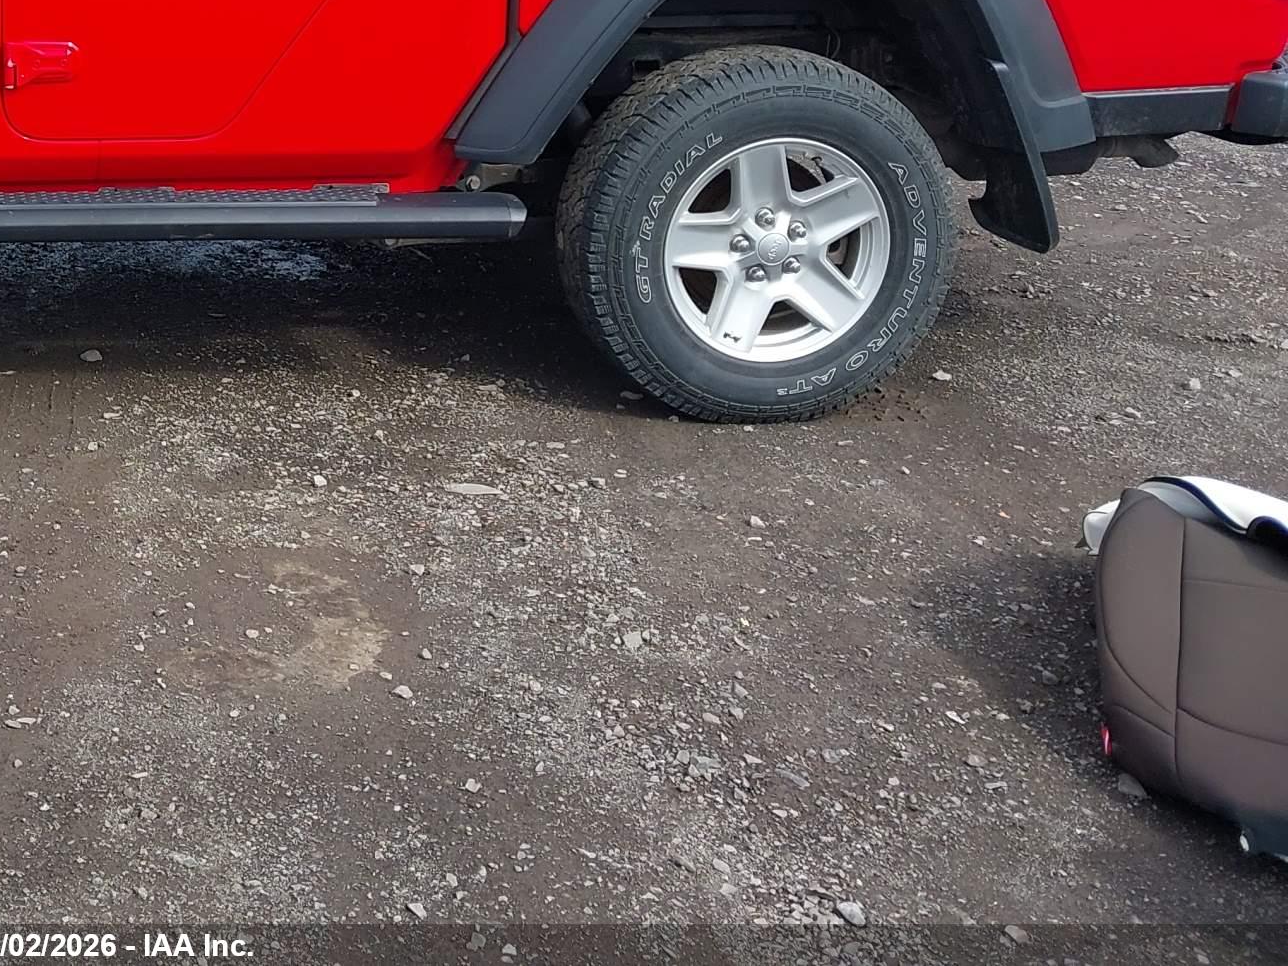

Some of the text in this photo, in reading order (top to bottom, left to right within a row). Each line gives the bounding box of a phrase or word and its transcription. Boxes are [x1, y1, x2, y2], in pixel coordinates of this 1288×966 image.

[635, 132, 723, 304] GT RADIAL
[845, 162, 927, 372] ADVENTURO
